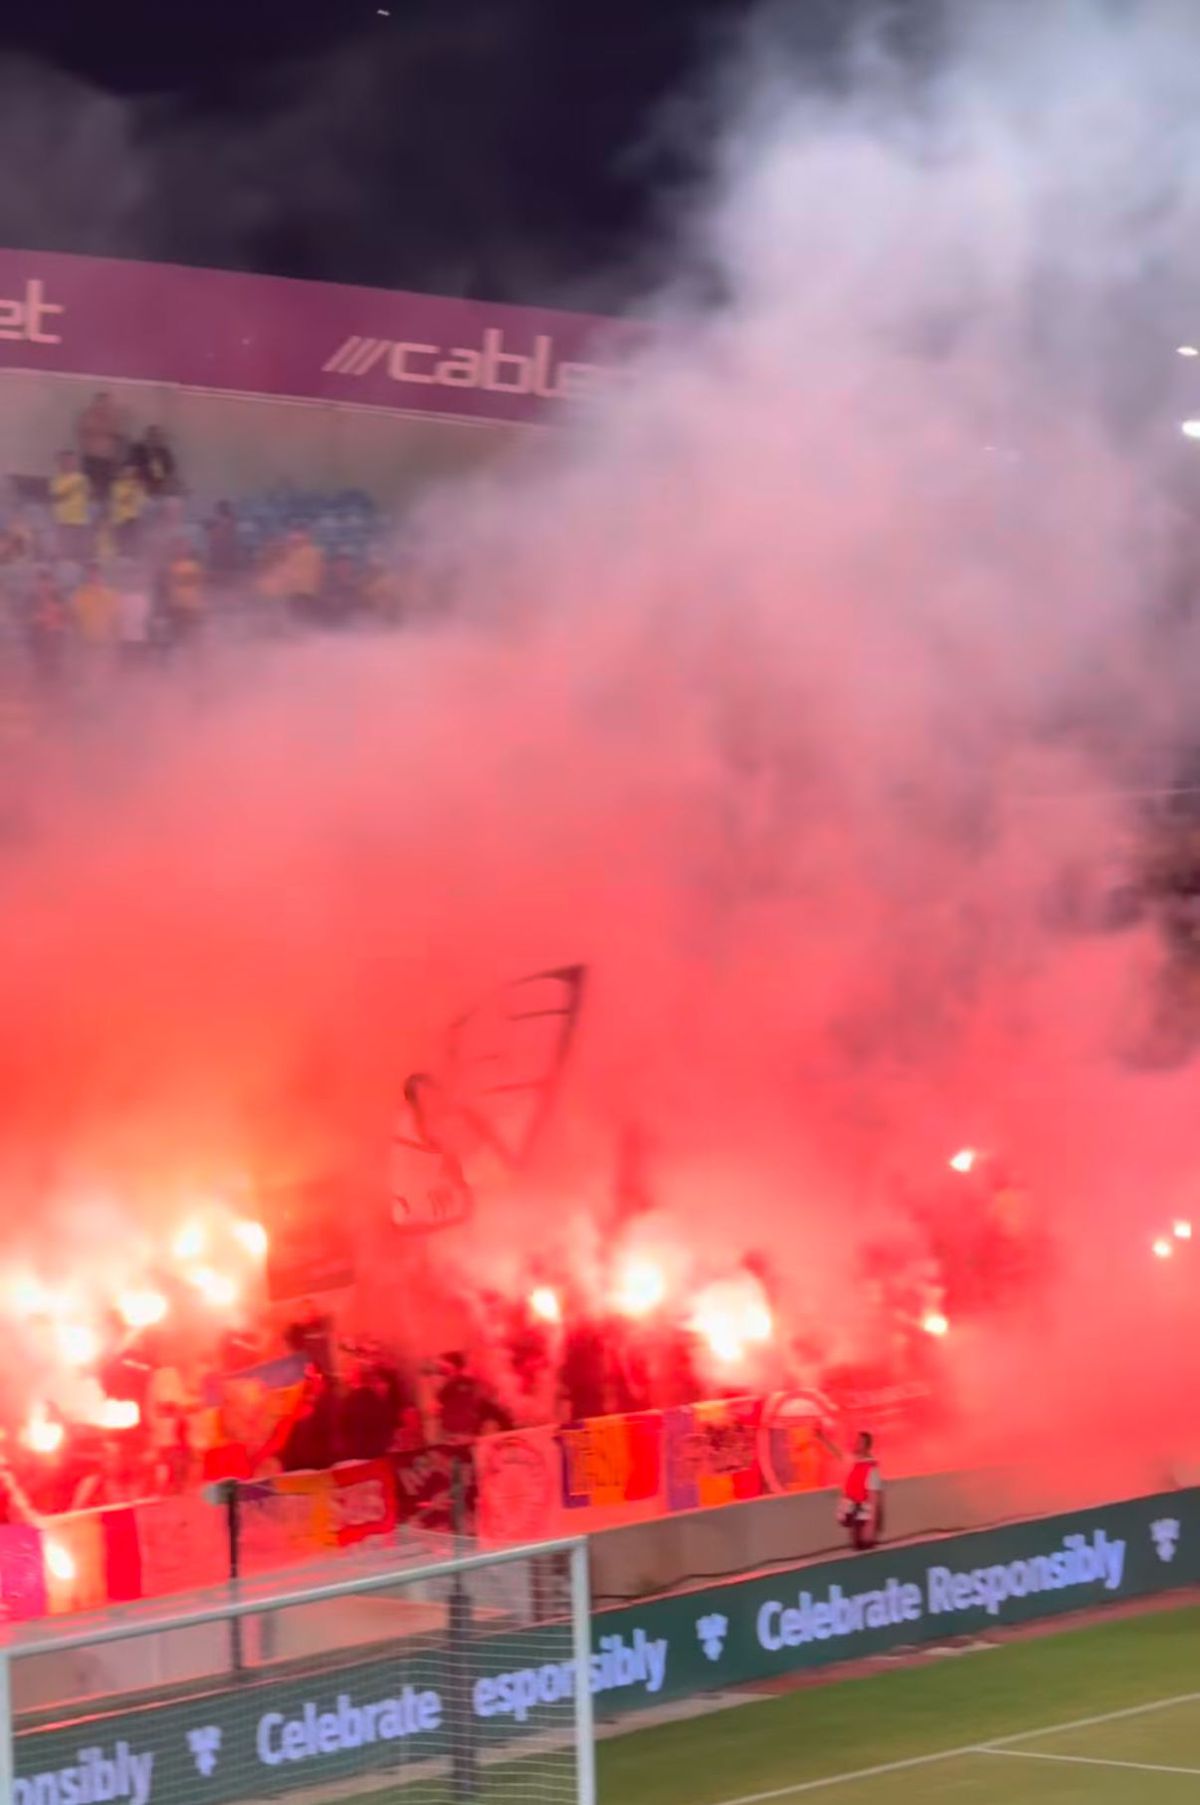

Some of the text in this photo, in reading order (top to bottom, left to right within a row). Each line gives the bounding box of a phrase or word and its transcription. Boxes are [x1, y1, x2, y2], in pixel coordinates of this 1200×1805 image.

[387, 328, 608, 399] cable
[757, 1529, 1126, 1650] Celebrate Responsibly
[257, 1628, 667, 1765] Celebrate esponsibly
